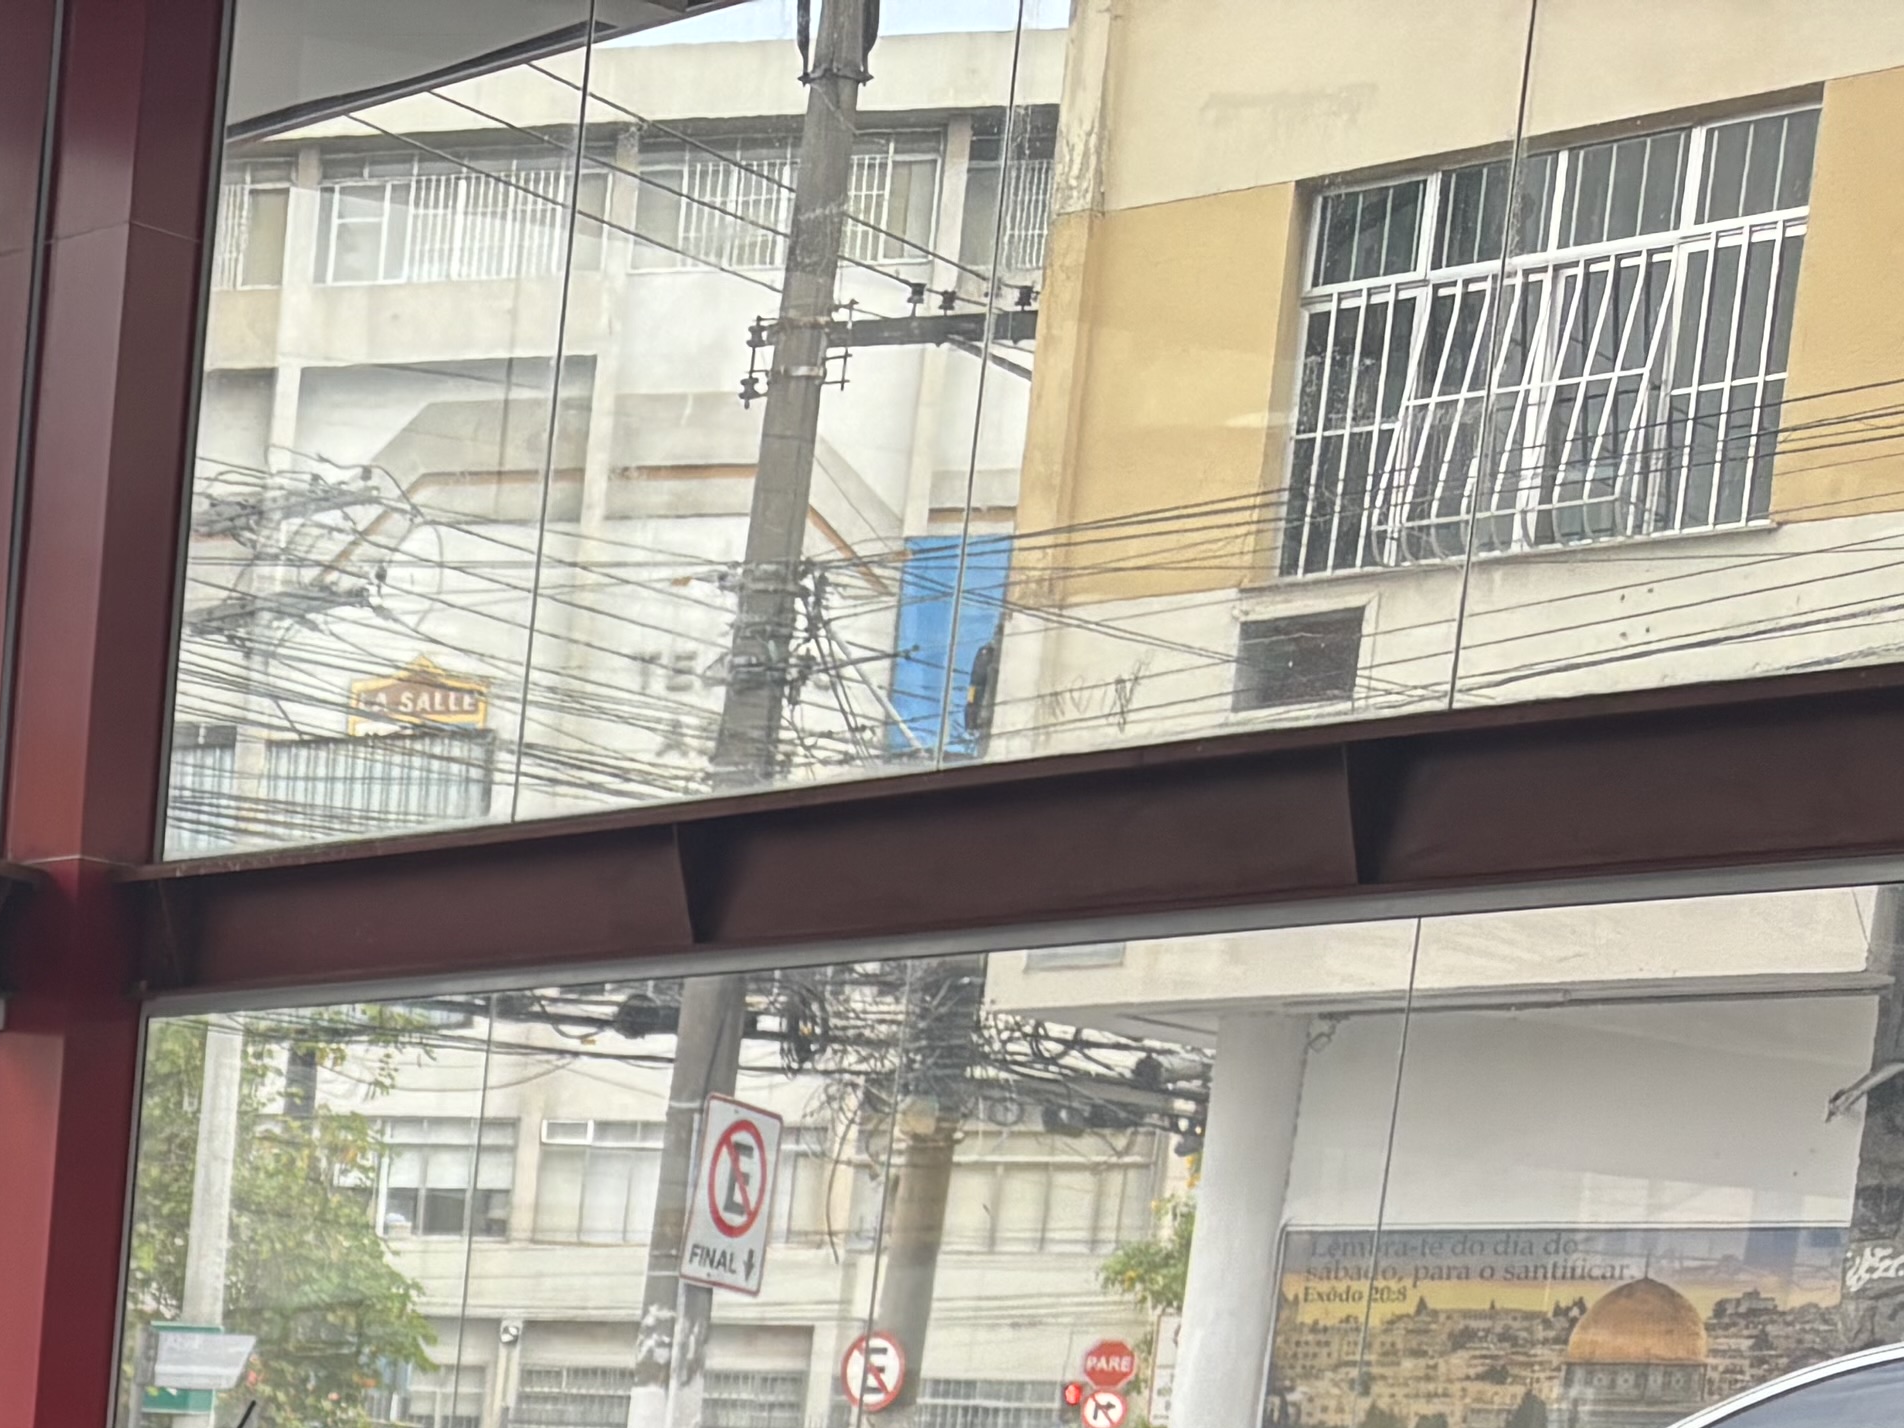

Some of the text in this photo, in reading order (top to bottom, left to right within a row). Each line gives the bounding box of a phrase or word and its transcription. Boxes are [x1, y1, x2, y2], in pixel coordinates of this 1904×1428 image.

[398, 691, 477, 712] SALLE
[1451, 1234, 1484, 1257] do
[1493, 1233, 1534, 1256] dia
[1543, 1232, 1578, 1256] do
[689, 1244, 737, 1274] FINAL
[1413, 1264, 1470, 1288] para
[1479, 1265, 1495, 1281] o
[1087, 1356, 1132, 1372] PARE
